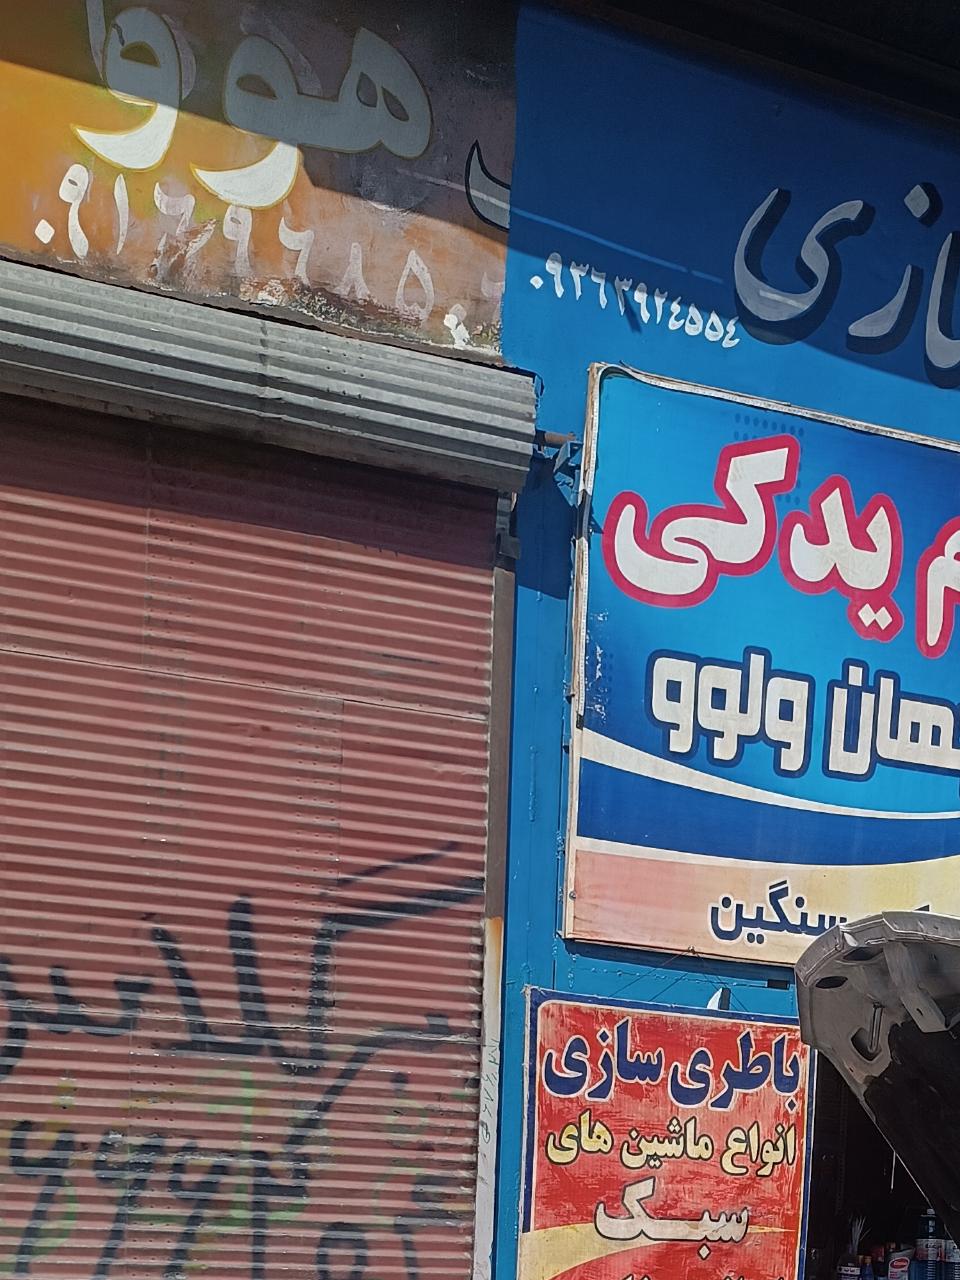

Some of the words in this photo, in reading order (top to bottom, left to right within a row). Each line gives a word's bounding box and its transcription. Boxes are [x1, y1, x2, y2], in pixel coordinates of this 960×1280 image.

[602, 433, 903, 643] یدکی
[646, 645, 812, 778] ولوو
[544, 1018, 663, 1100] سازی
[669, 1031, 801, 1111] باطری
[546, 1108, 613, 1166] های
[620, 1116, 714, 1167] ماشین
[720, 1121, 796, 1177] انواع
[594, 1177, 749, 1260] سبک
